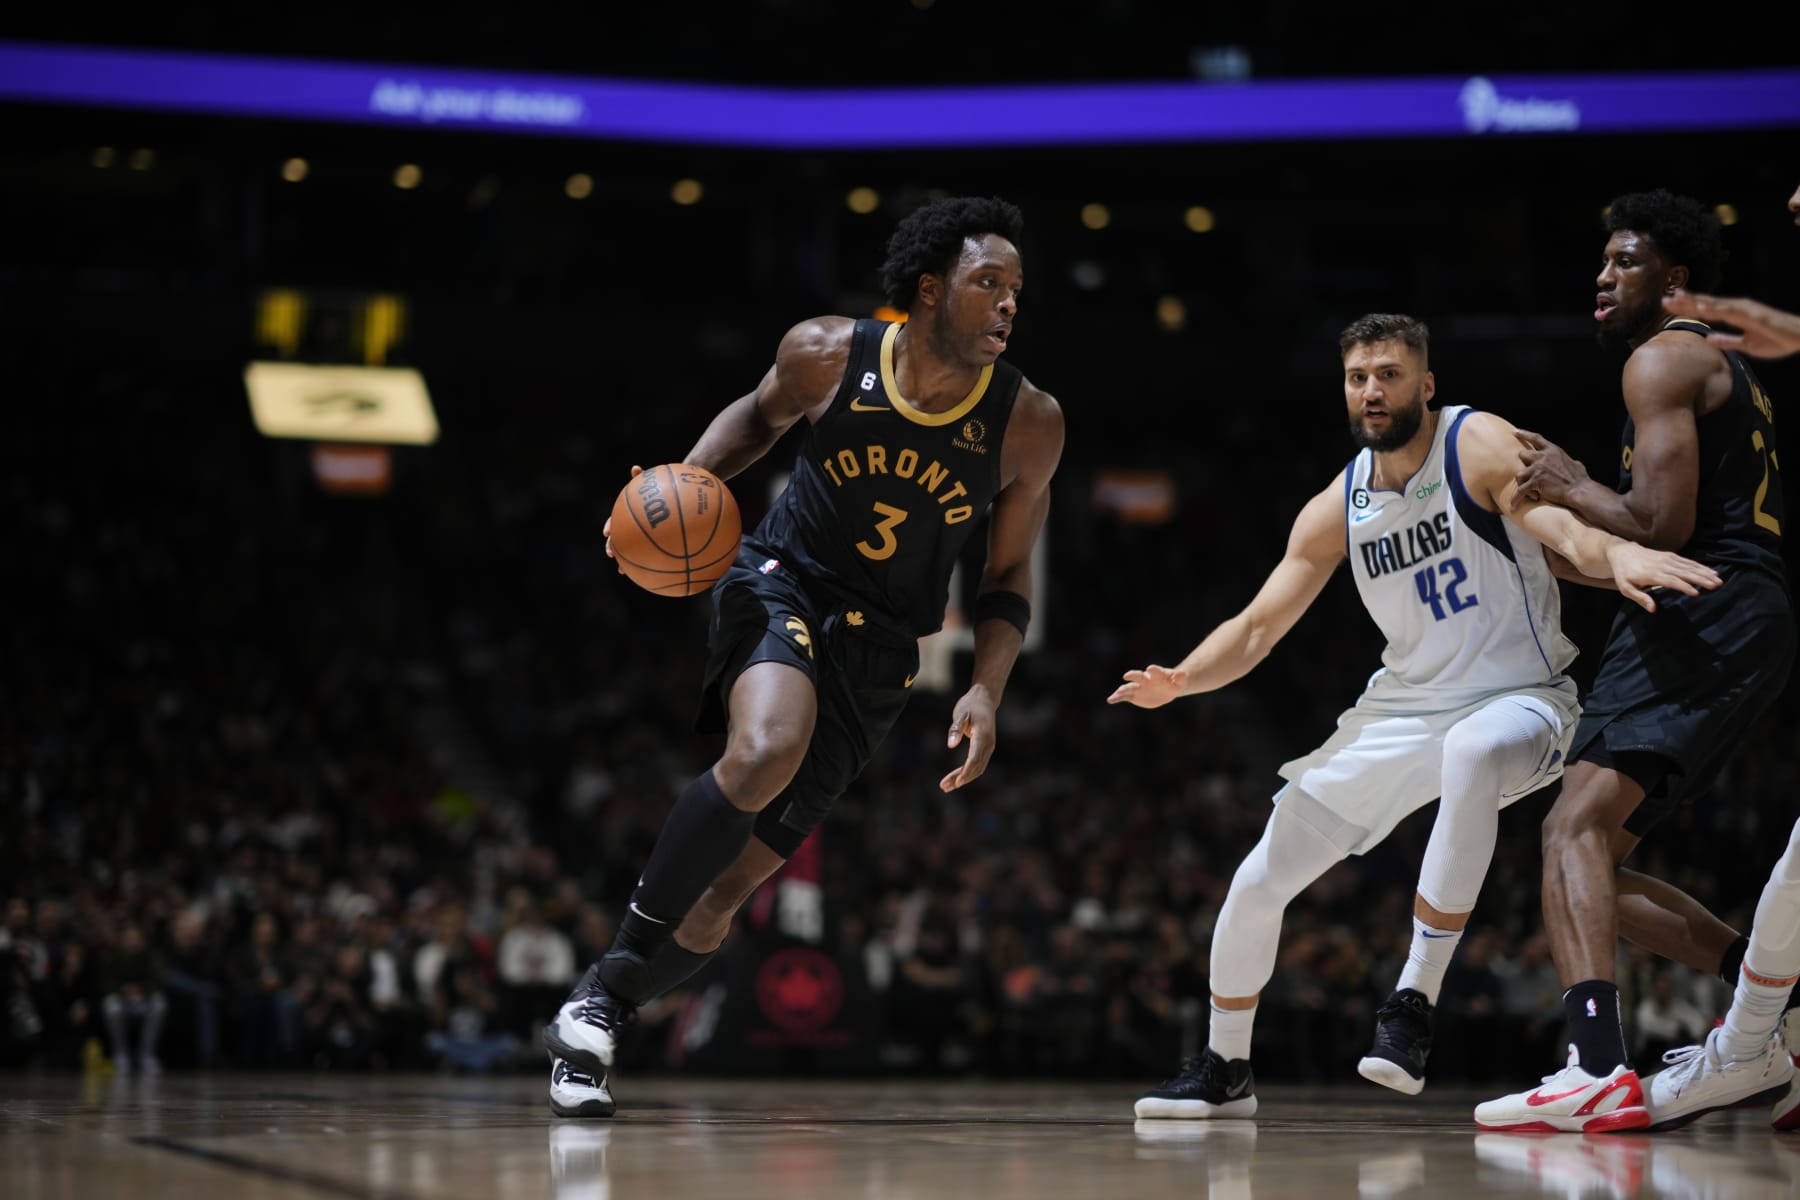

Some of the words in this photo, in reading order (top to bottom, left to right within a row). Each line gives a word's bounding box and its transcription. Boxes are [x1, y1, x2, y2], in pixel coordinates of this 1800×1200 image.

[860, 371, 877, 391] 6
[952, 437, 970, 449] Sun
[970, 442, 988, 455] Life
[824, 445, 973, 525] TORONTO
[1353, 489, 1369, 508] 6
[856, 501, 909, 561] 3
[1359, 510, 1453, 580] DALLAS
[1414, 557, 1479, 621] 42
